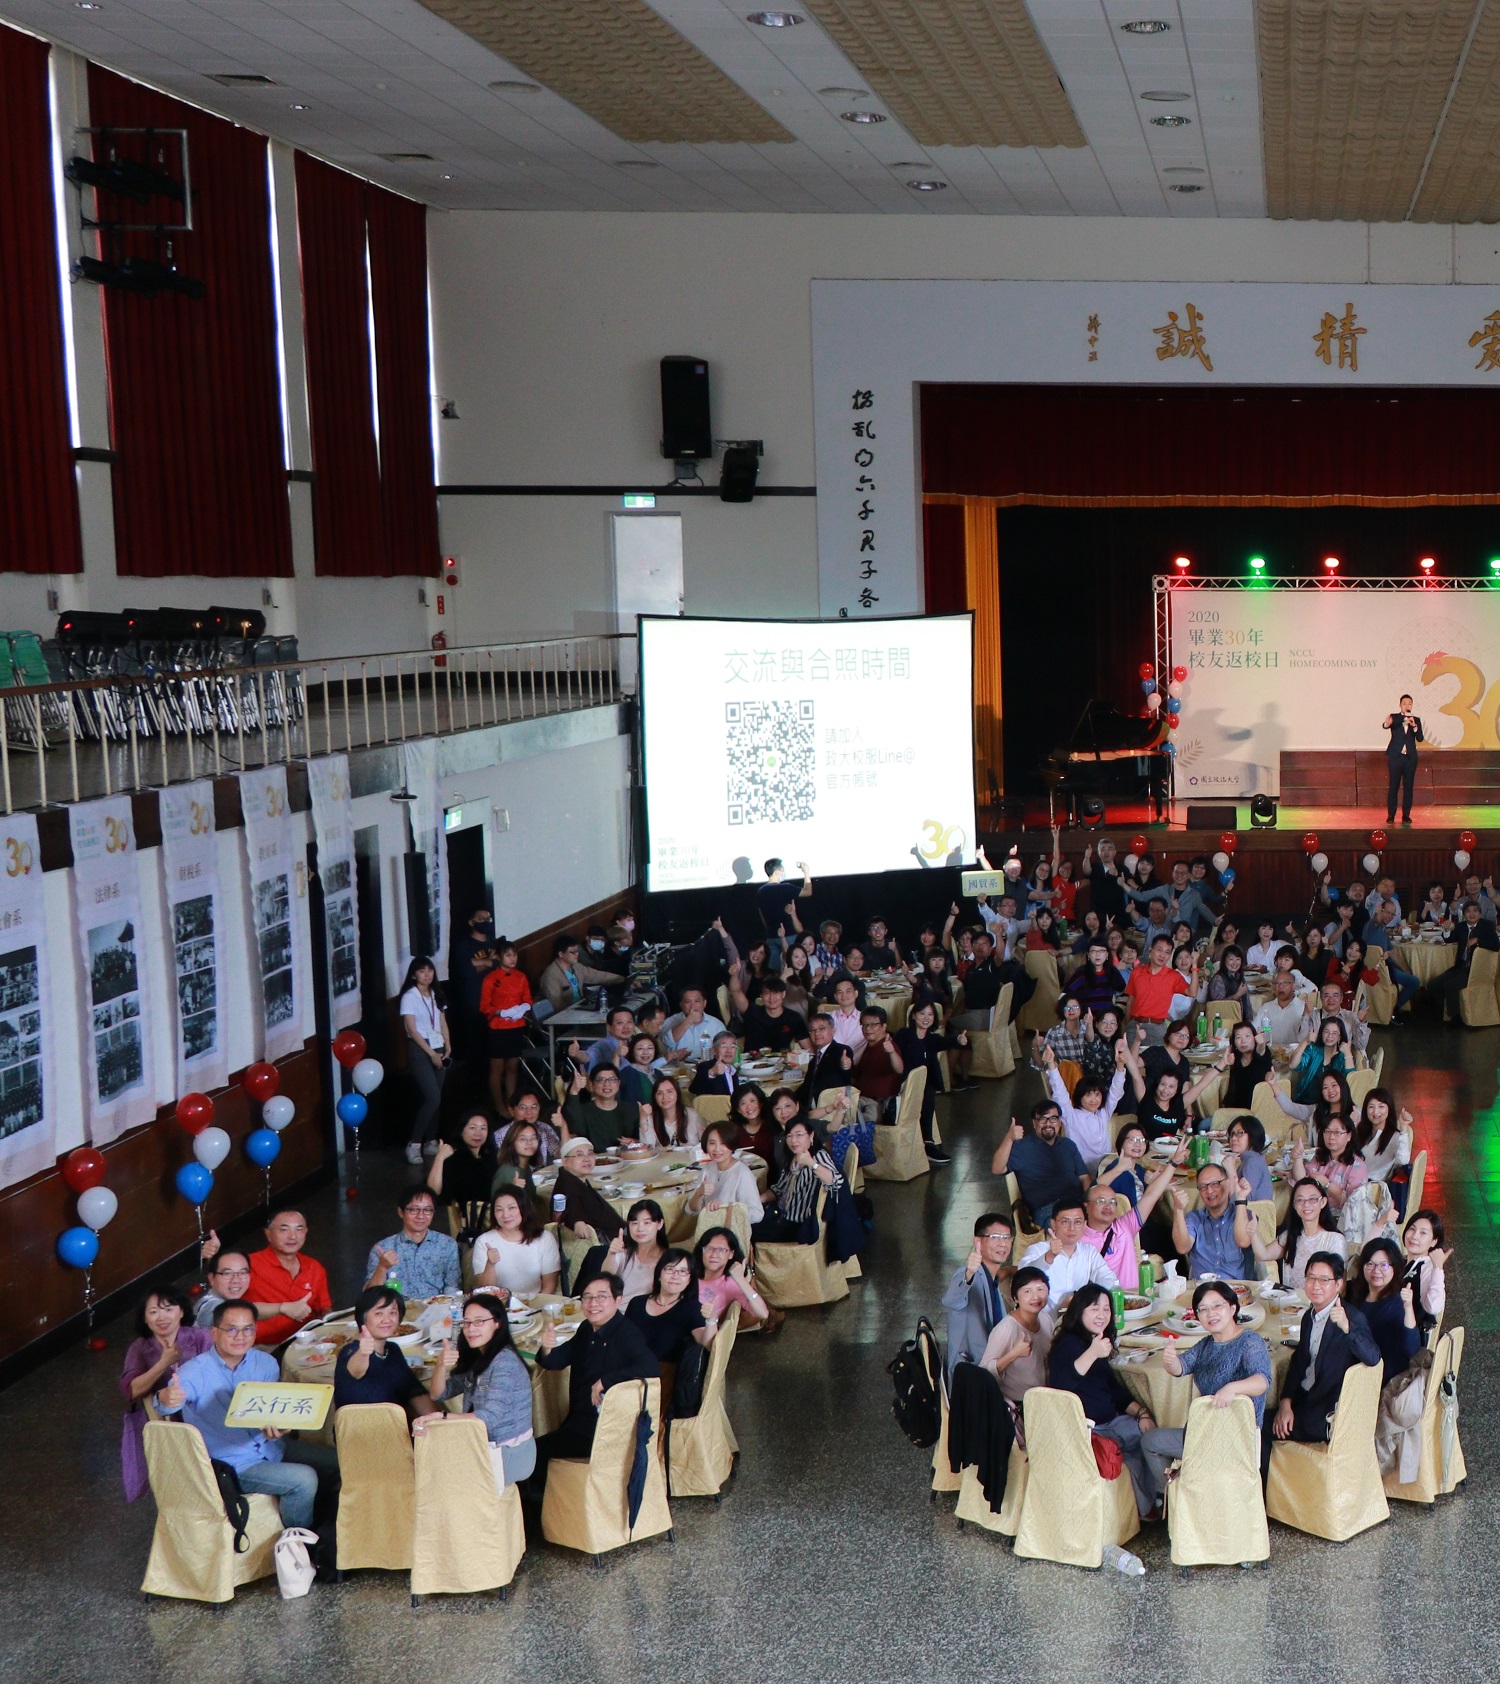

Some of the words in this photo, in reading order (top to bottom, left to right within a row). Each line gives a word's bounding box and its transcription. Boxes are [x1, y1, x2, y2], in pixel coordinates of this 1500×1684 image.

[1188, 611, 1220, 623] 2020
[1188, 629, 1264, 646] 畢業30年
[1188, 651, 1279, 669] 校友返校日
[1289, 649, 1316, 657] NCCU
[724, 647, 911, 684] 交流與合照時間
[1289, 659, 1358, 668] HOMECOMING
[1360, 659, 1378, 668] DAY
[825, 727, 864, 745] 請加入
[826, 771, 878, 789] 官方帳號
[245, 1396, 314, 1415] 公行系
